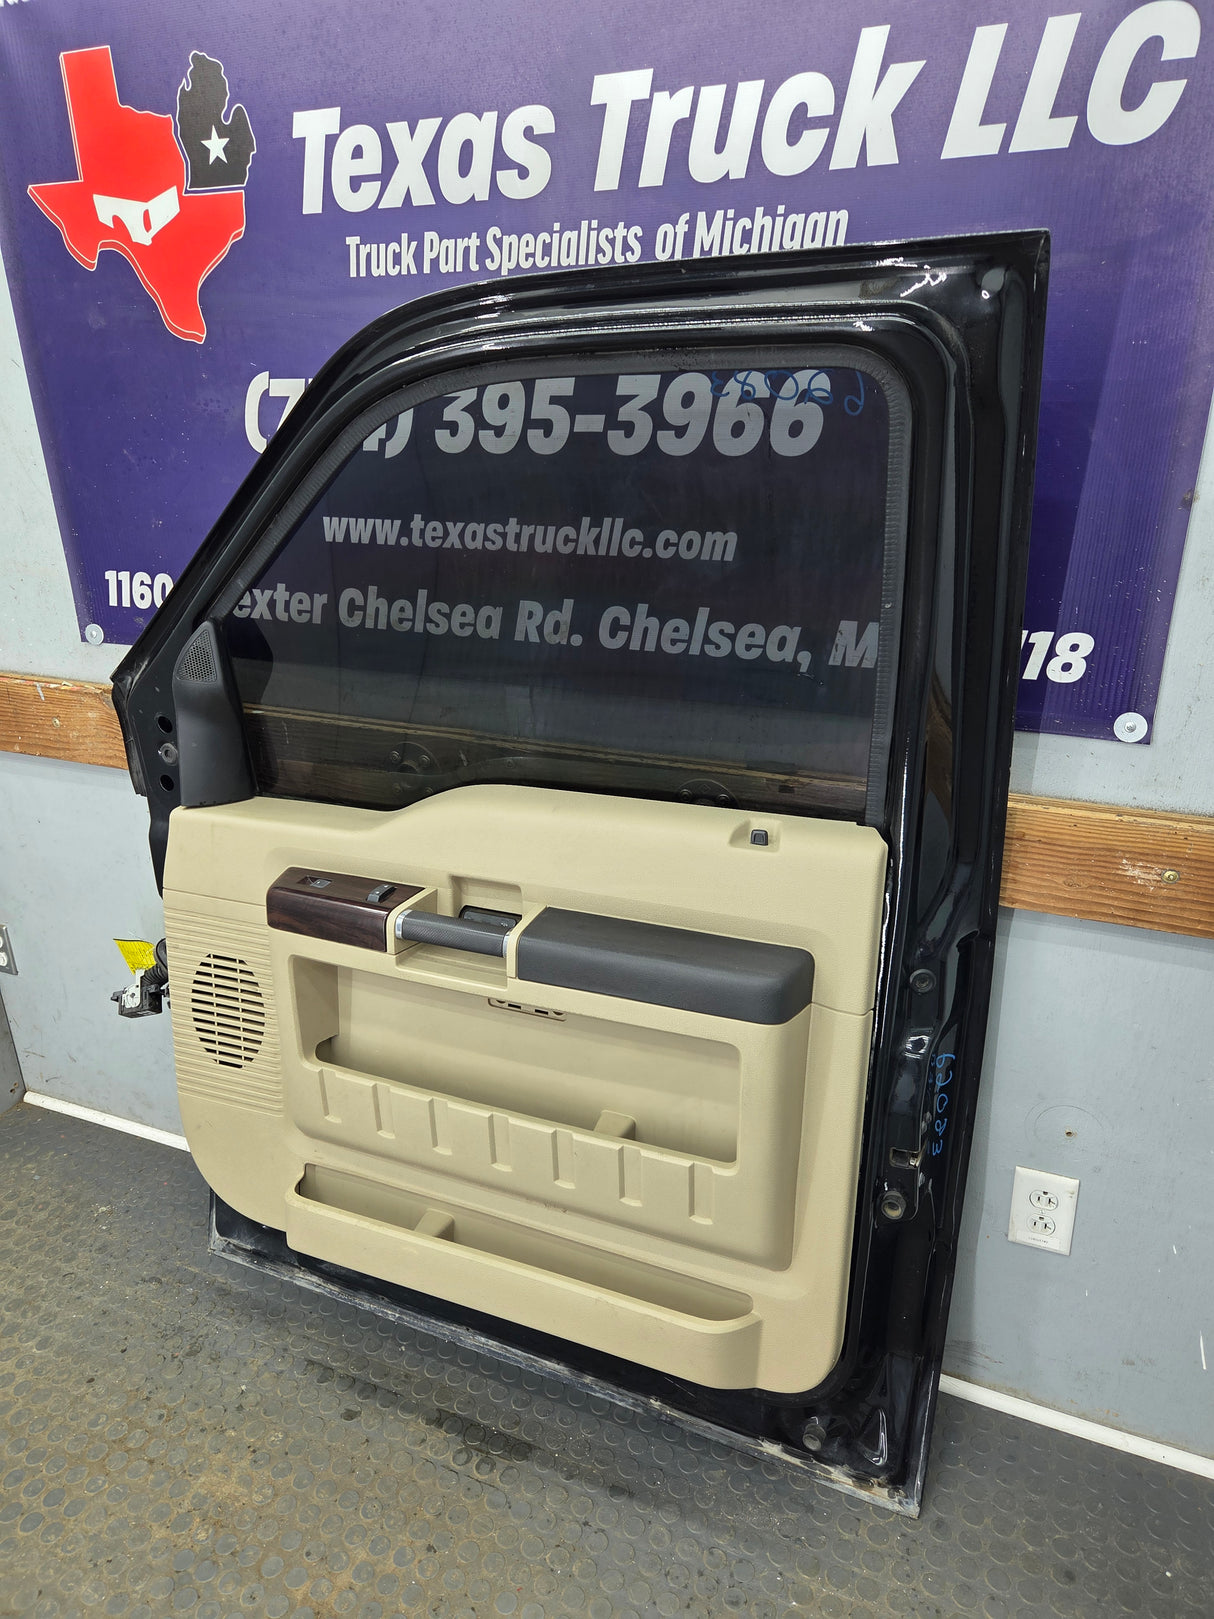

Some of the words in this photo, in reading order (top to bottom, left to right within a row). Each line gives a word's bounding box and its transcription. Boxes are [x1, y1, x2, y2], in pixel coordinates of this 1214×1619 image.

[292, 104, 556, 215] Texas
[590, 23, 927, 192] Truck
[940, 0, 1201, 160] LLC
[345, 232, 418, 278] Truck
[424, 230, 481, 274] Part
[485, 219, 643, 277] Specialists
[655, 212, 690, 261] of
[692, 204, 850, 260] Michigan
[433, 370, 828, 457] 395-3966
[323, 513, 738, 562] www.texastruckllc.com
[232, 582, 328, 625] exter
[338, 585, 502, 639] Chelsea
[514, 598, 583, 647] Rd.
[598, 604, 812, 673] Chelsea,
[828, 620, 880, 669] M
[1021, 629, 1095, 684] 18
